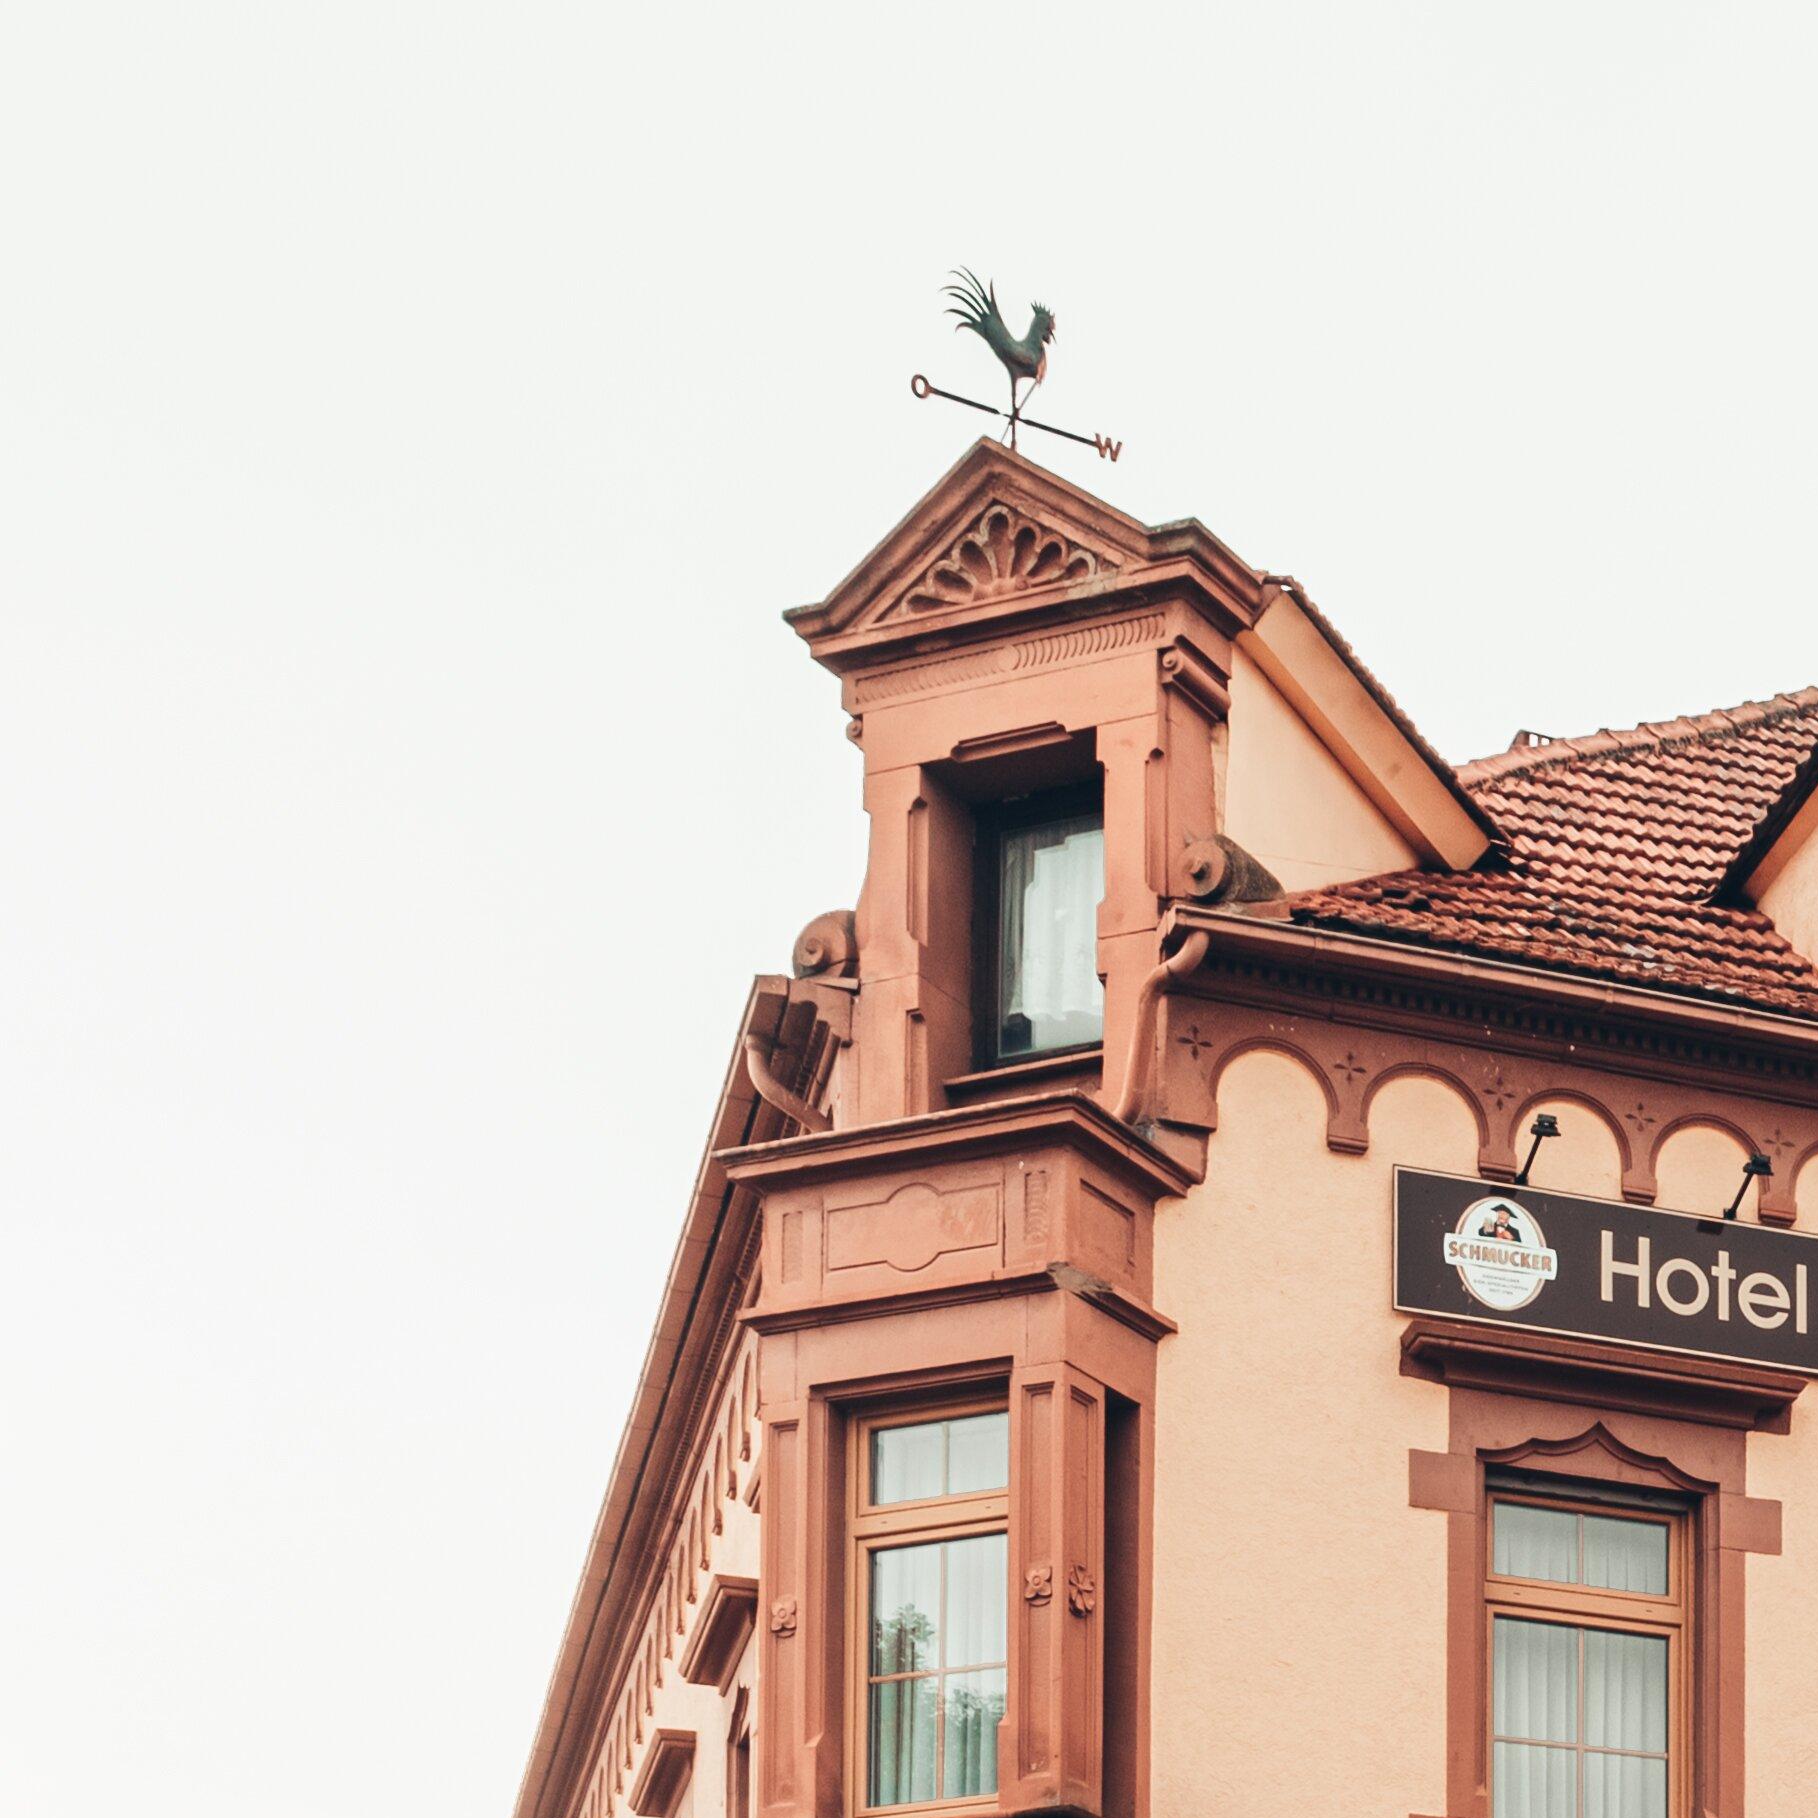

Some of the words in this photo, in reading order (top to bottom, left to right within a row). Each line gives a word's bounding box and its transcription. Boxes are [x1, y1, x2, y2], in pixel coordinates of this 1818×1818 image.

[1094, 432, 1122, 463] W
[1448, 1240, 1552, 1272] SCHMUCKER
[1600, 1229, 1808, 1335] Hotel
